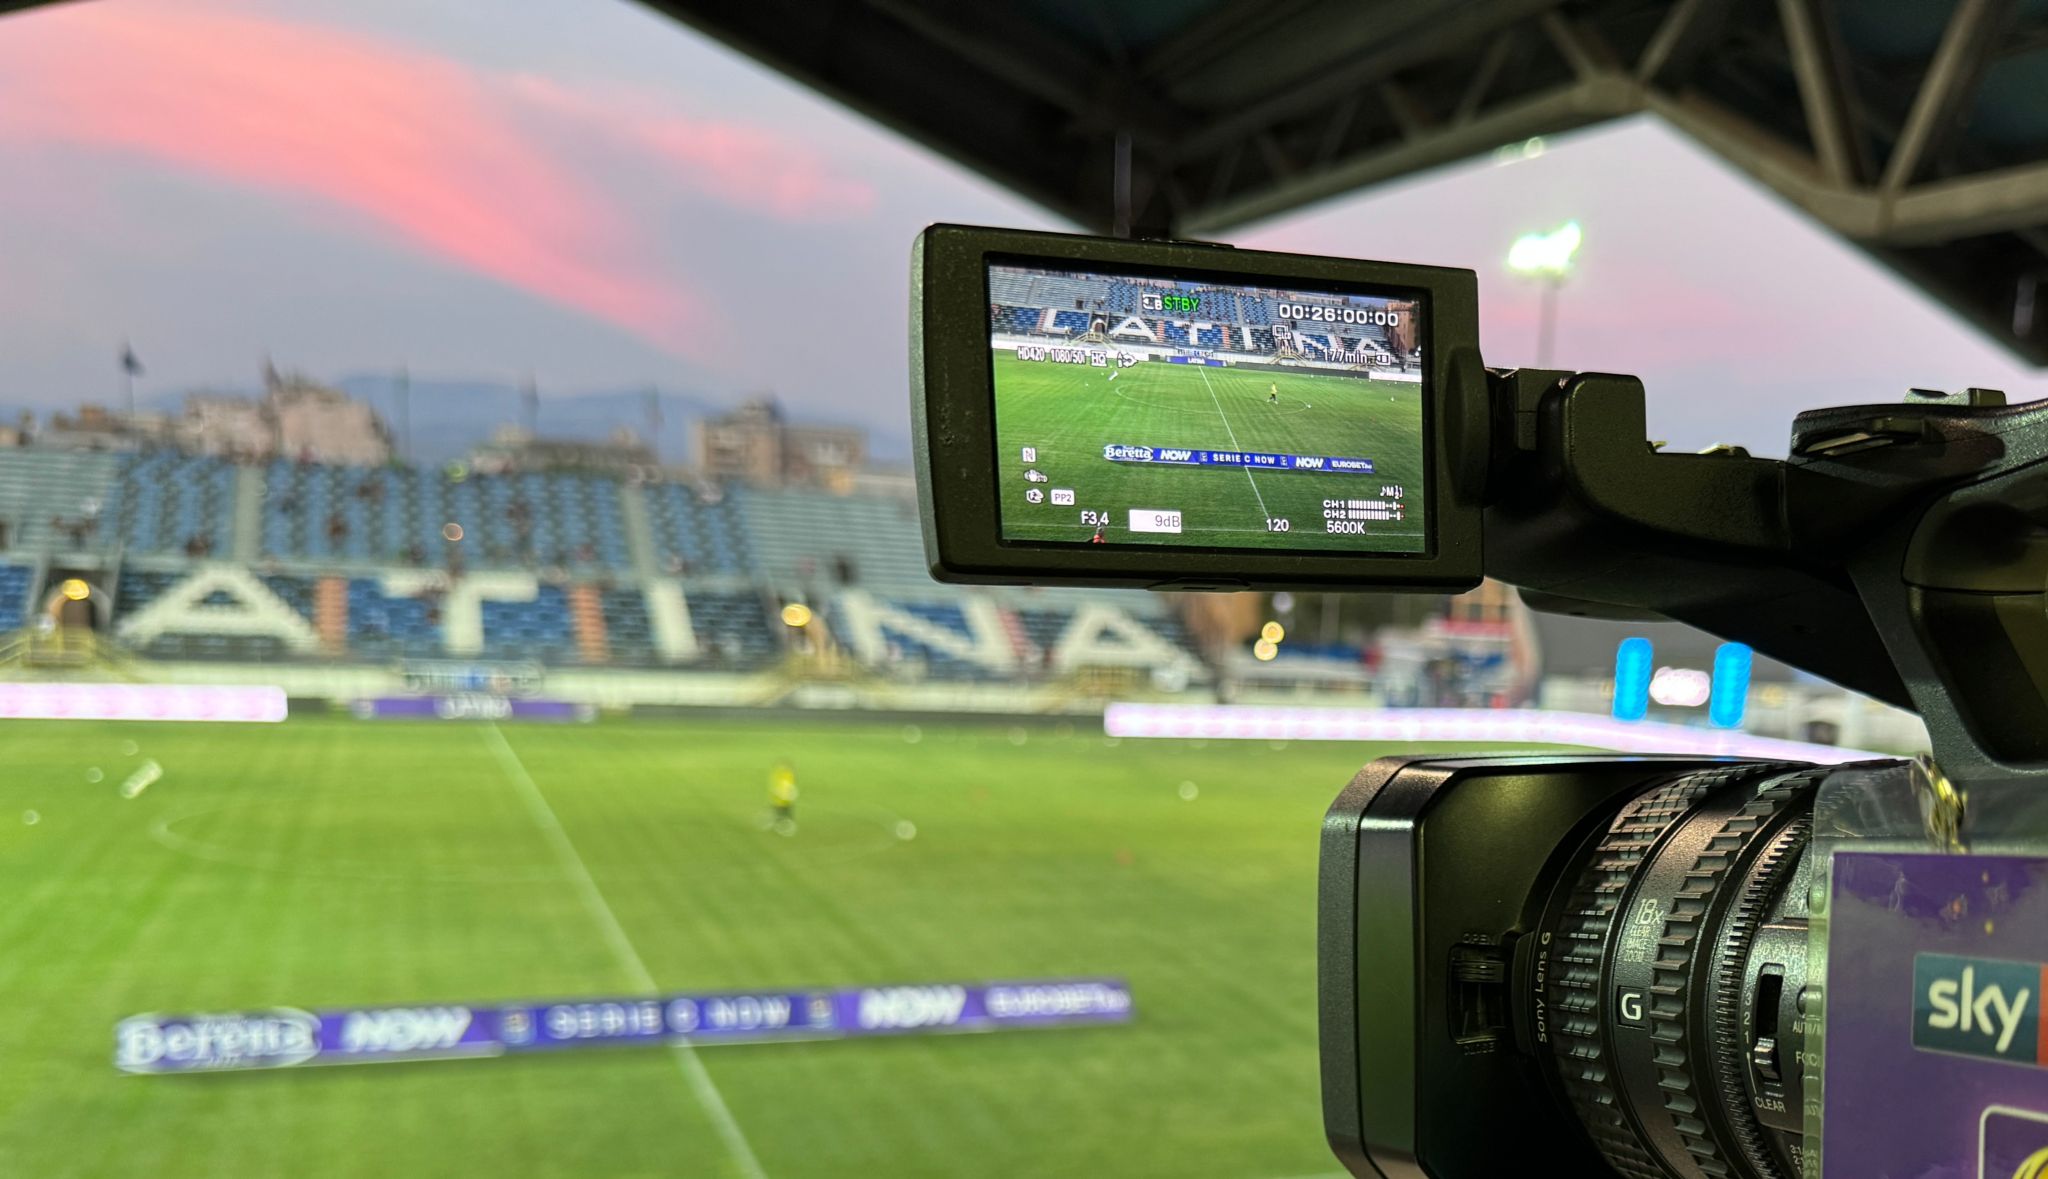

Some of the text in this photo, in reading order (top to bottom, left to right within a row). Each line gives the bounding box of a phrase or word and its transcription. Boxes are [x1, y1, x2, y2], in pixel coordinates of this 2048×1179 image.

[1164, 295, 1200, 312] STBY
[1279, 303, 1400, 327] 00:26:00:00
[1017, 346, 1045, 362] HD420
[1103, 446, 1152, 459] Beretta
[1160, 449, 1192, 461] NOW
[1212, 453, 1241, 463] SERIE
[1244, 455, 1251, 464] C
[1254, 456, 1276, 465] NOW
[1295, 456, 1325, 469] NOW
[1054, 493, 1072, 503] PP2
[1323, 499, 1346, 509] CH1
[1323, 509, 1347, 519] CH2
[1154, 514, 1181, 528] 9dB
[1266, 518, 1290, 532] 120
[1326, 520, 1366, 535] 5600K
[1541, 931, 1551, 945] G
[1621, 992, 1642, 1021] G
[1744, 992, 1752, 1006] 3
[1928, 965, 2031, 1054] sky
[1743, 1013, 1751, 1025] 2
[1744, 1031, 1749, 1044] 1
[1754, 1095, 1787, 1113] CLEAR
